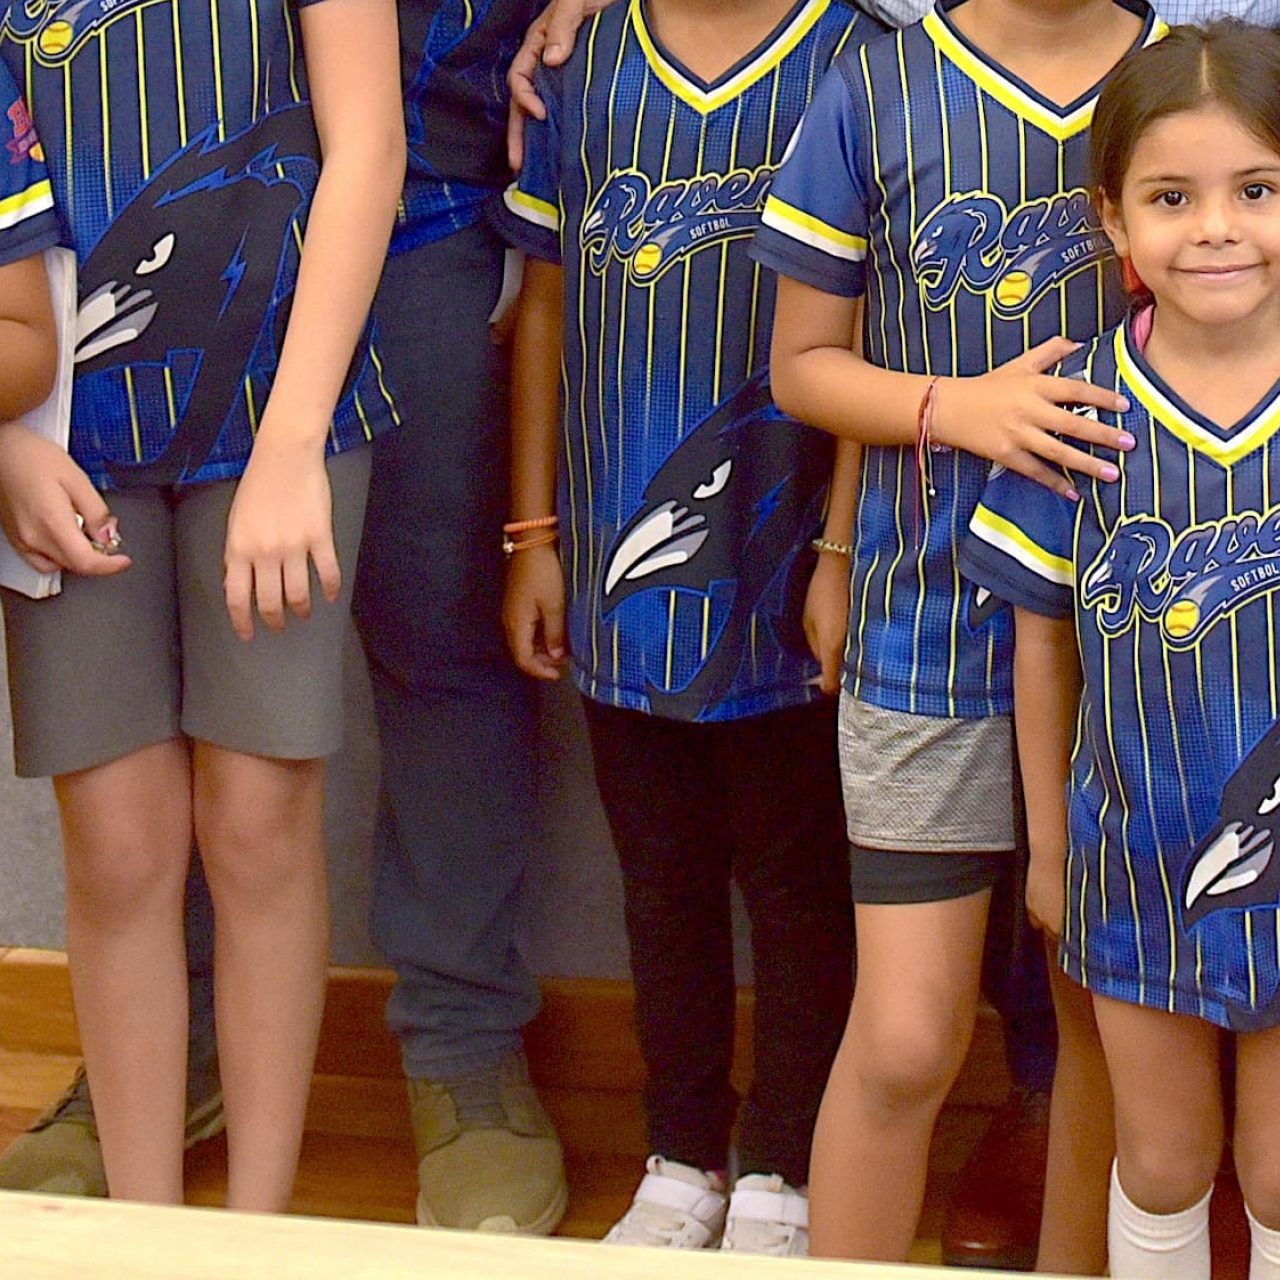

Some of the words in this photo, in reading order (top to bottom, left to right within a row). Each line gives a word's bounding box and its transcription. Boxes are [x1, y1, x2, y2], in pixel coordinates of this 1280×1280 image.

[584, 172, 773, 269] Rave
[690, 219, 730, 239] SOFTBOL
[1230, 563, 1279, 593] SOFTBOL
